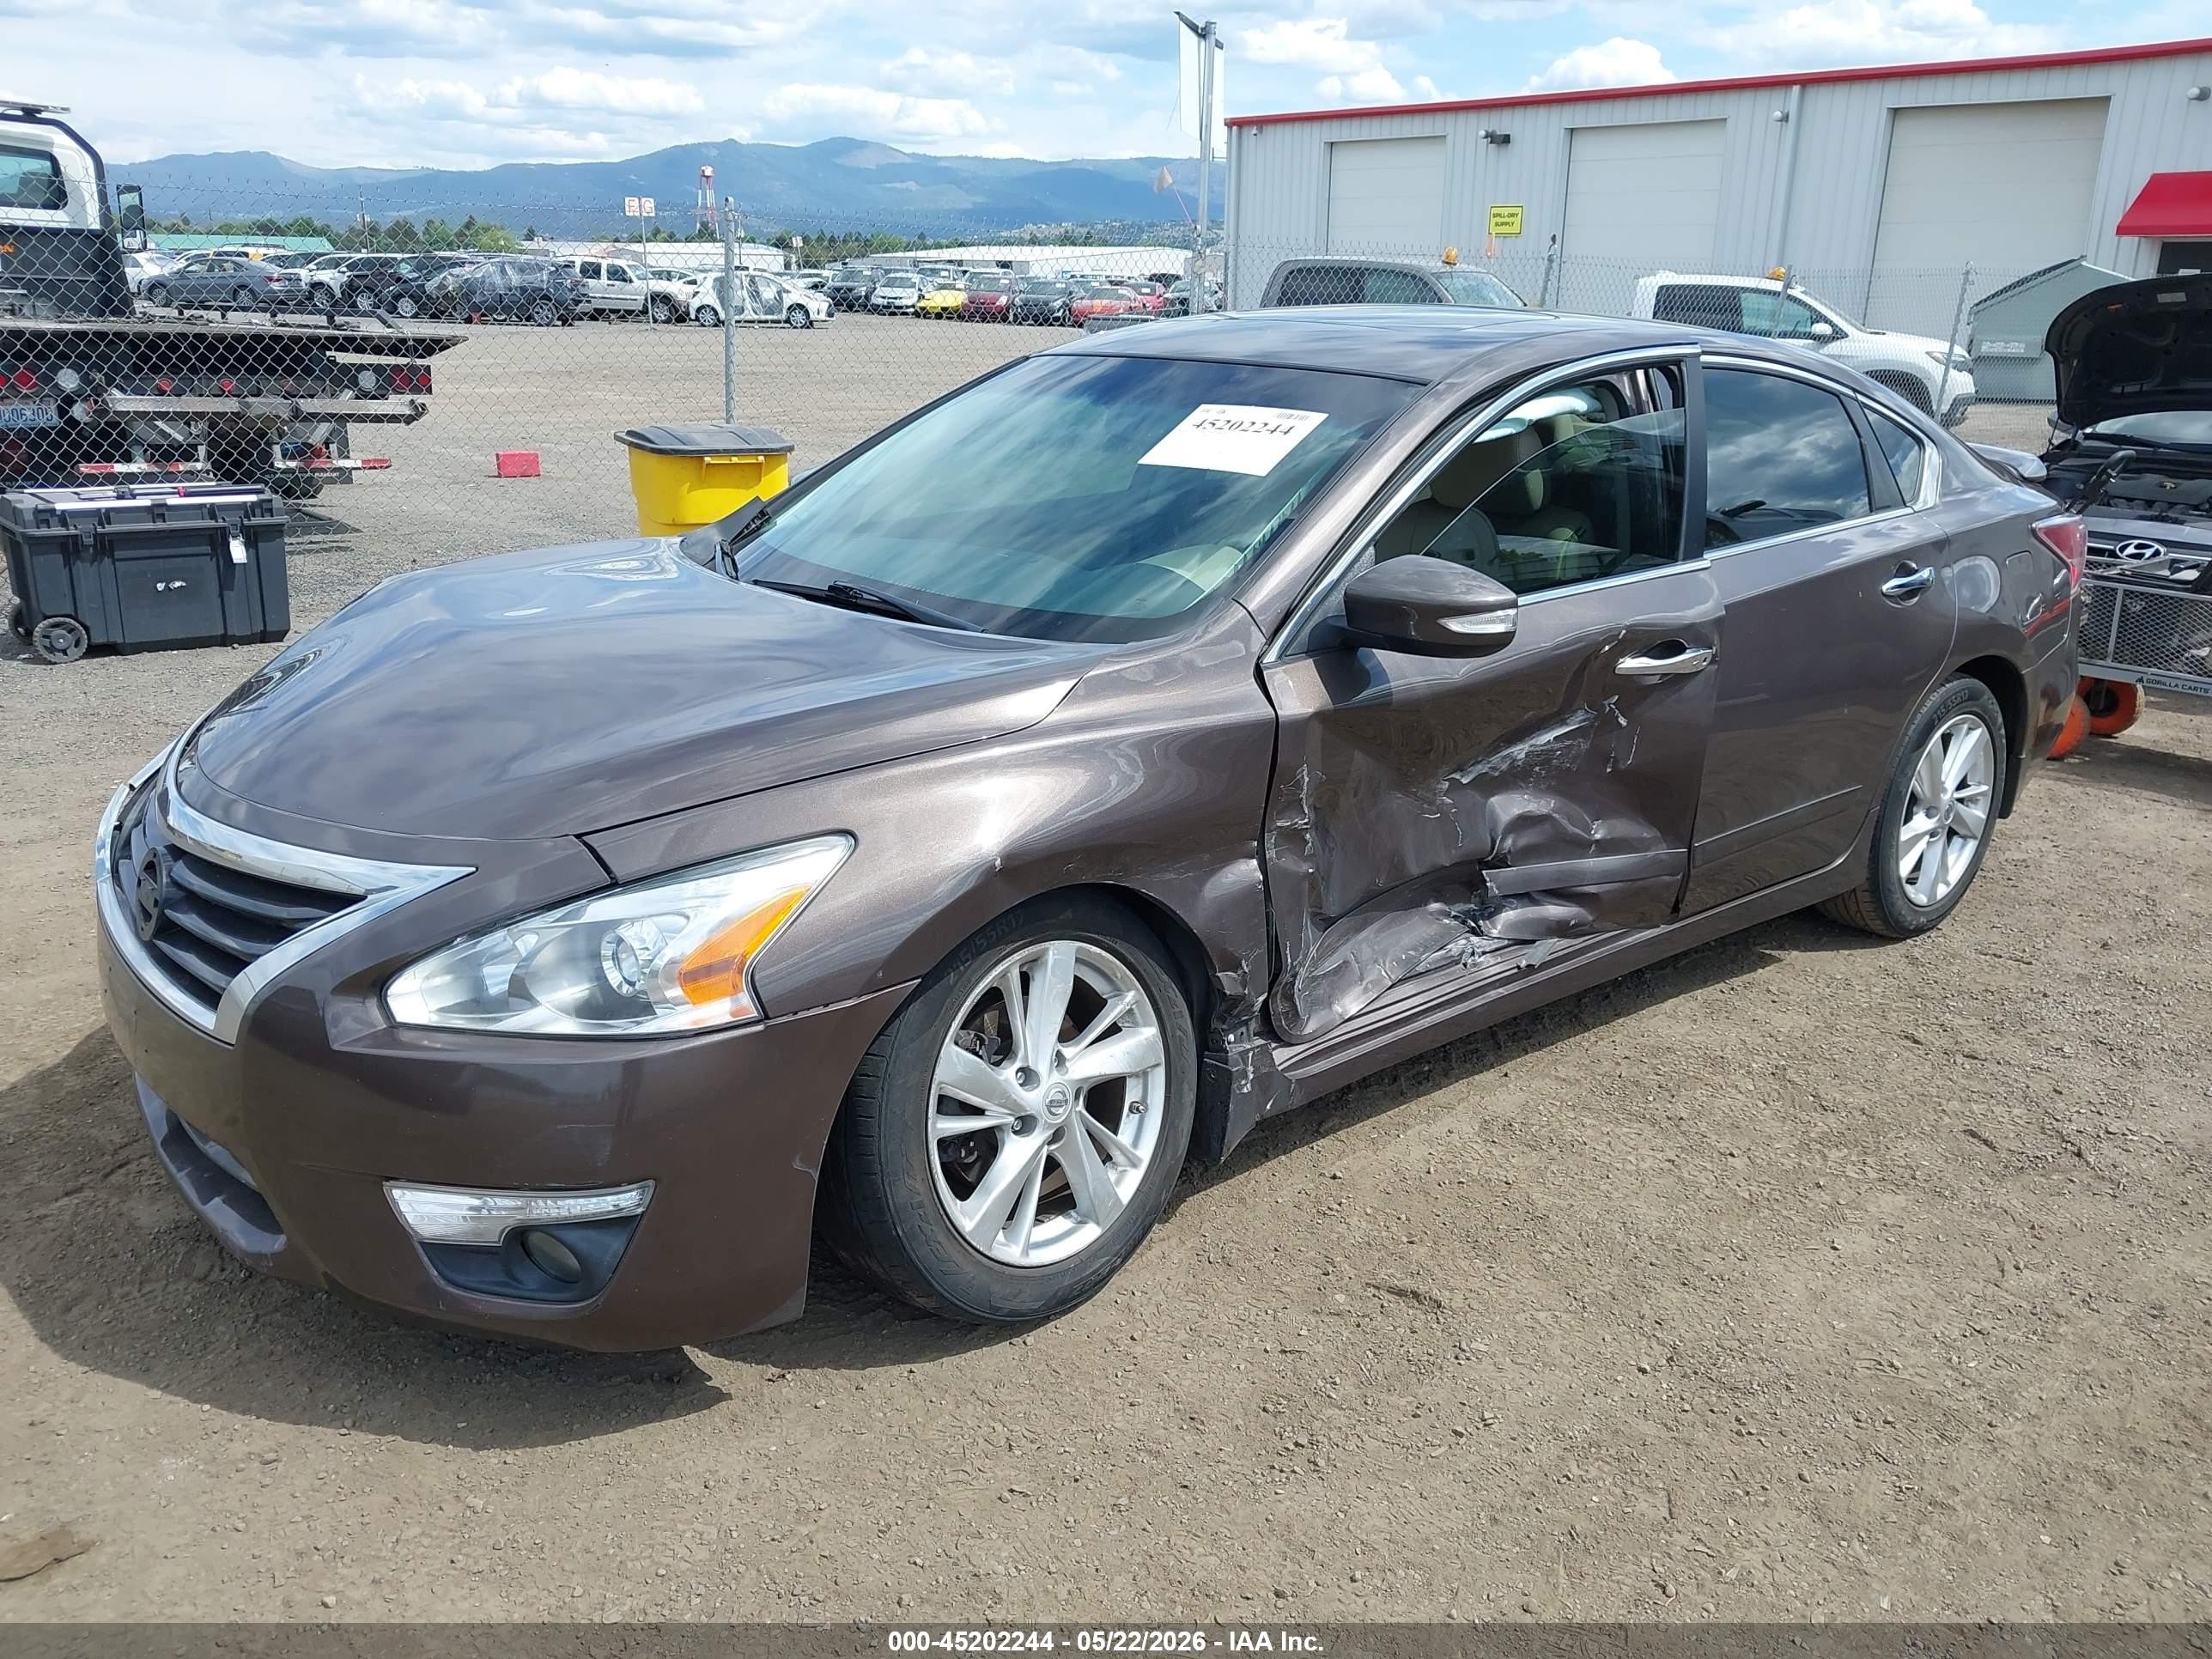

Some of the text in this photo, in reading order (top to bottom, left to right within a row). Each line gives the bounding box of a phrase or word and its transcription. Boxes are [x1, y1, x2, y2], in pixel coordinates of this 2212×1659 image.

[1192, 418, 1296, 436] 45202244
[2146, 678, 2209, 694] GORILLA CARTS
